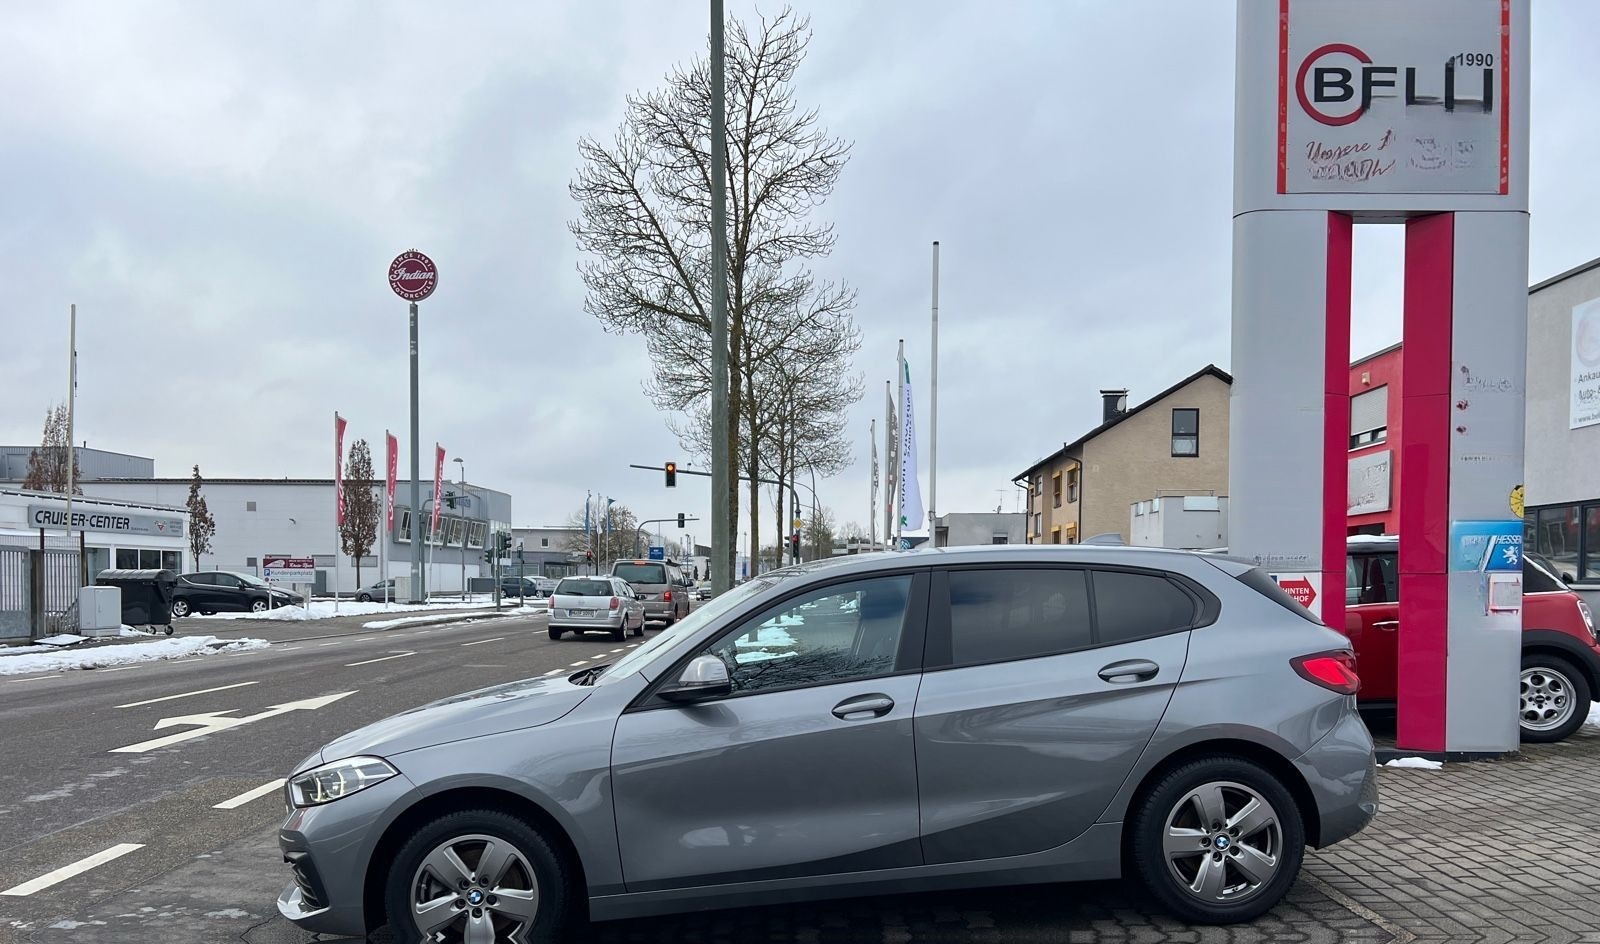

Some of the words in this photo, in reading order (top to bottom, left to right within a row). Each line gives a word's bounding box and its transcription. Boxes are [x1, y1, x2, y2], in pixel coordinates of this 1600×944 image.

[1457, 53, 1494, 67] 1990
[392, 253, 413, 269] SINCE
[417, 254, 432, 267] 1901
[389, 267, 434, 281] Indian
[392, 280, 433, 298] MOTORCYCLE
[271, 569, 313, 577] Kundenparkplatz
